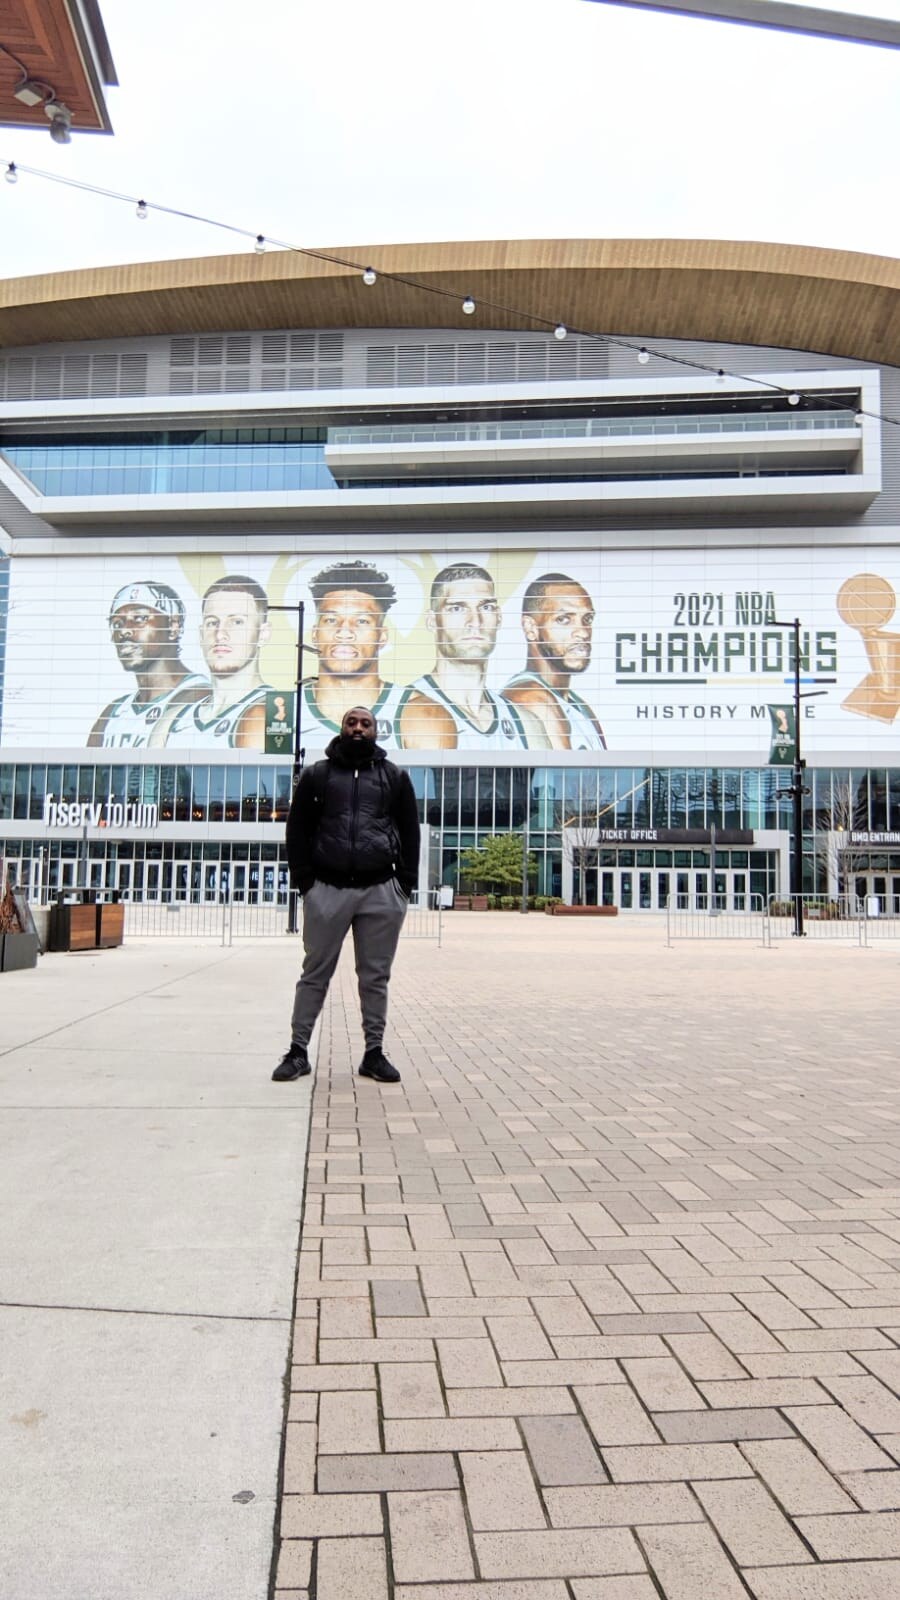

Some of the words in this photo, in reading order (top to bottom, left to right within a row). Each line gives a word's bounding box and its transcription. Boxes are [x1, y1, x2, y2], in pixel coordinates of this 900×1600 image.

[673, 592, 724, 626] 2021
[735, 591, 776, 626] NBA
[615, 631, 837, 673] CHAMPIONS
[636, 705, 737, 719] HISTORY
[750, 705, 816, 719] ME
[601, 829, 628, 840] TICKET
[630, 829, 658, 841] OFFICE
